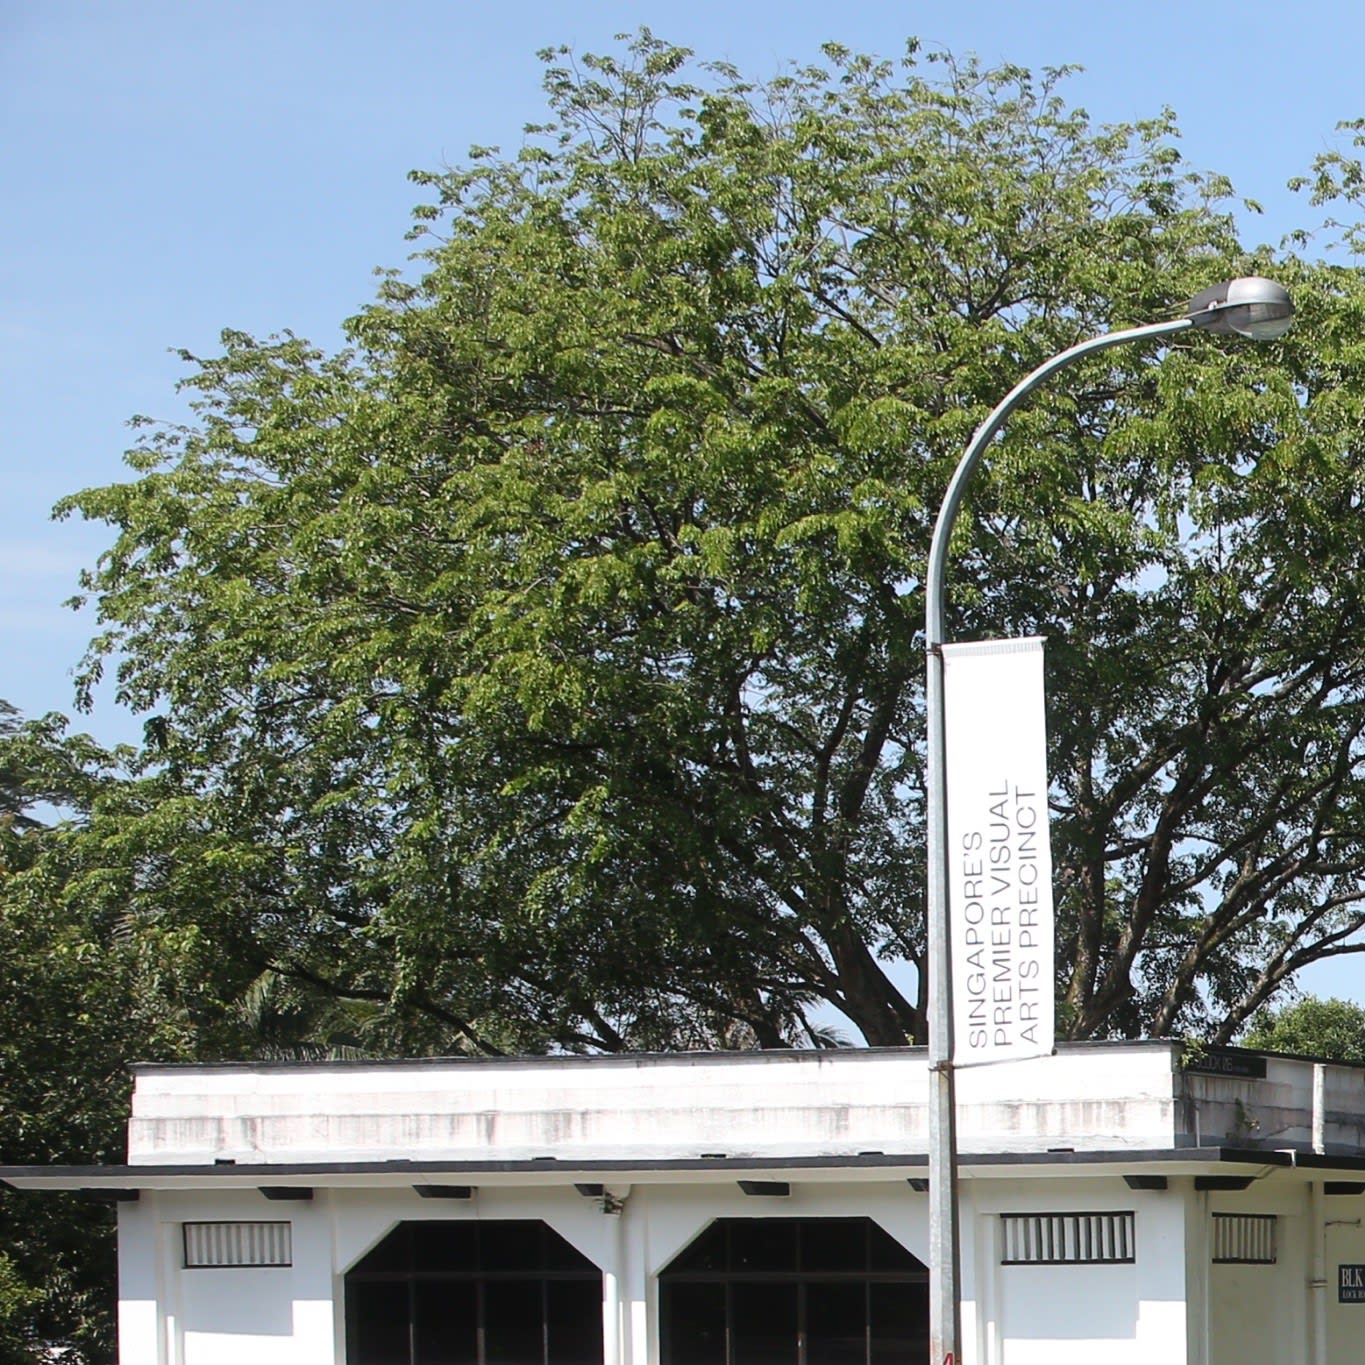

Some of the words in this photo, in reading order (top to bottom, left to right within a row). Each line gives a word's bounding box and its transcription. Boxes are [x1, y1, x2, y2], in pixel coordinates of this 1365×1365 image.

[989, 779, 1011, 895] VISUAL
[1016, 785, 1038, 947] PRECINCT
[963, 832, 987, 1048] SINGAPORE'S
[990, 907, 1012, 1046] PREMIER
[1018, 960, 1039, 1044] ARTS
[1342, 1268, 1363, 1287] BLK
